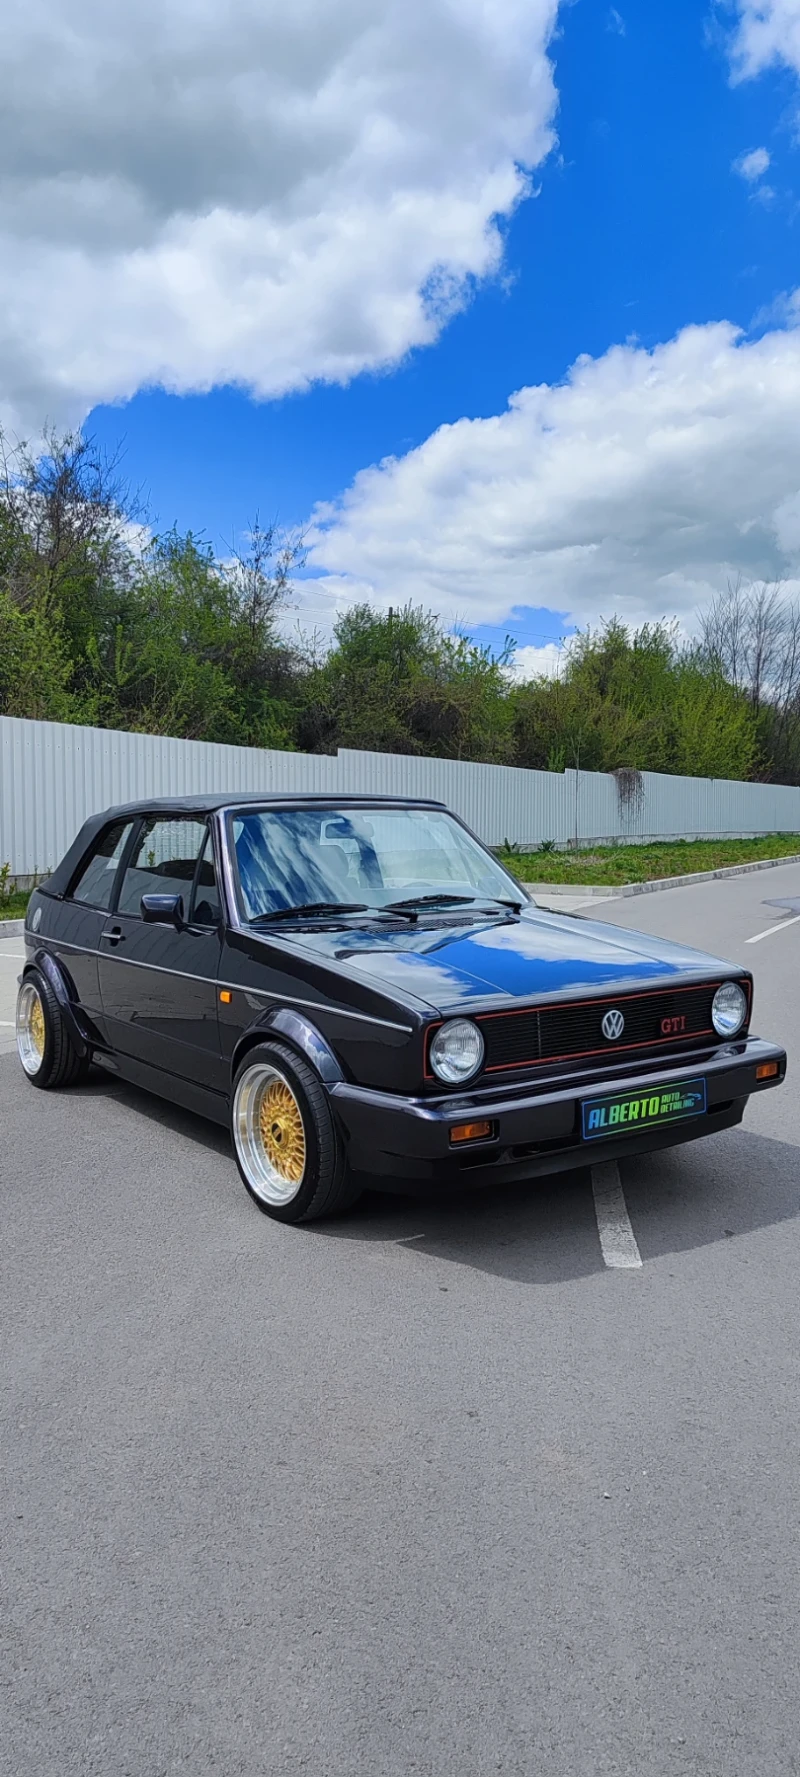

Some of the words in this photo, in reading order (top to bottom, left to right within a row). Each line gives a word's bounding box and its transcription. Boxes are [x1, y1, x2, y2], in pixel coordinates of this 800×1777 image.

[602, 1010, 624, 1039] VW
[661, 1016, 686, 1033] GTI
[660, 1098, 695, 1114] DETAILING
[661, 1092, 680, 1104] AUTO
[588, 1096, 660, 1130] ALBERTO
